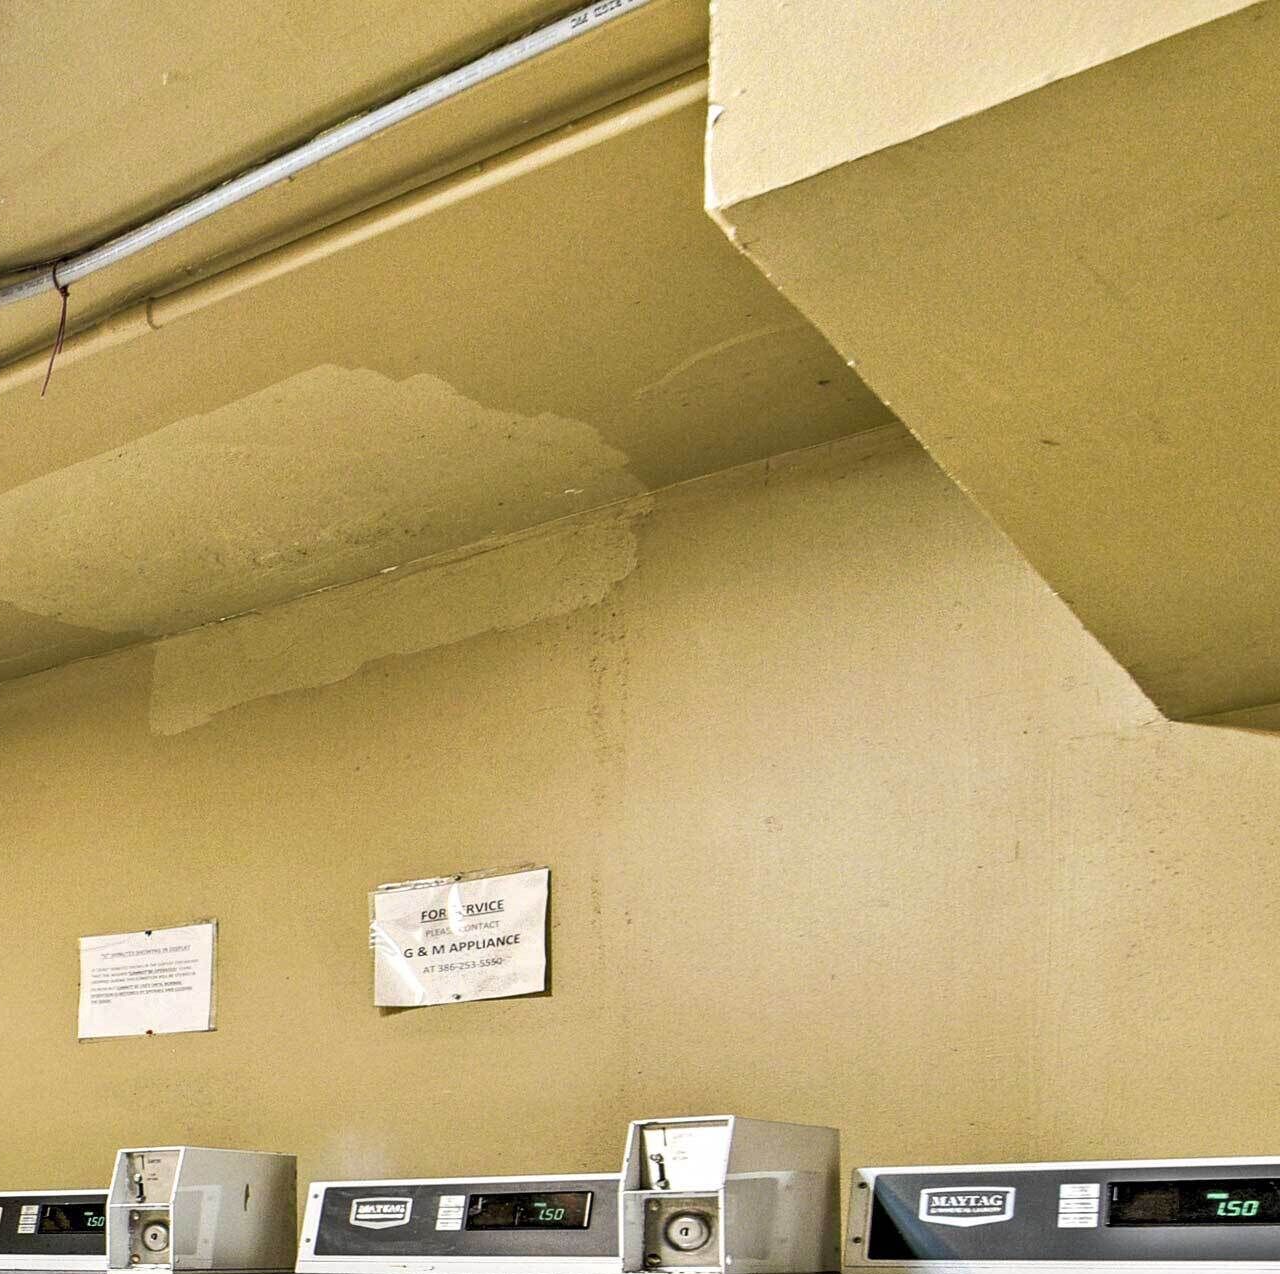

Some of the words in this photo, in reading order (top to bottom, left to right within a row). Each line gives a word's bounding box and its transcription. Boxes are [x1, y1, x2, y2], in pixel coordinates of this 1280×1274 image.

[421, 908, 446, 921] FOR
[451, 899, 504, 917] RVICE
[425, 926, 454, 937] PLEAS
[404, 948, 413, 958] G
[417, 946, 428, 956] &
[432, 944, 445, 955] M
[449, 933, 521, 953] APPLIANCE
[423, 965, 435, 974] AT
[930, 1195, 1003, 1207] MAYTAG
